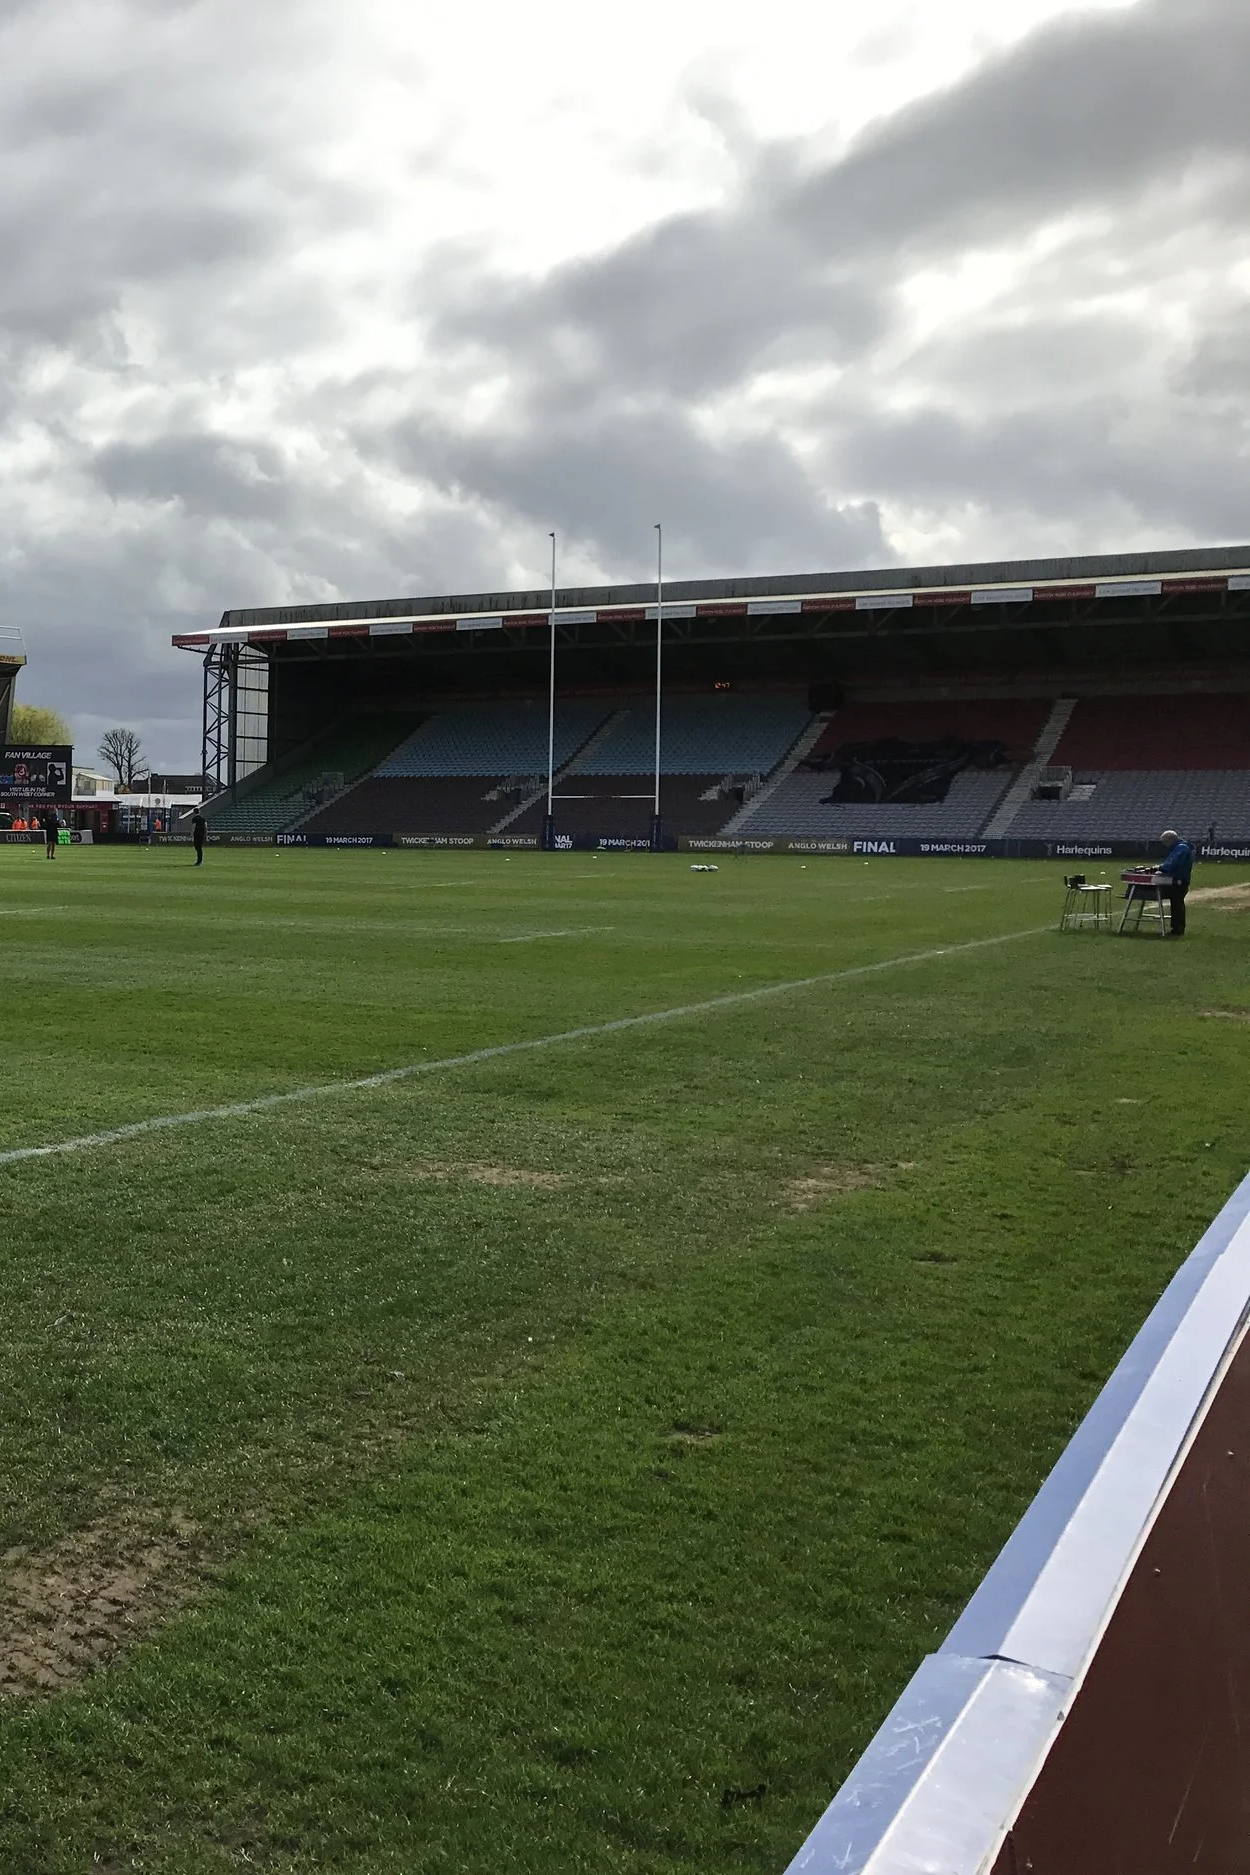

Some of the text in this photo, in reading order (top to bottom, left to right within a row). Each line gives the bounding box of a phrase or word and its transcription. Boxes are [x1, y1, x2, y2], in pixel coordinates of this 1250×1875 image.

[4, 751, 52, 760] FAN VILLAGE
[6, 833, 32, 842] CITIZEN
[277, 834, 307, 844] FINAL
[449, 837, 473, 845] STOOP
[599, 838, 650, 847] 19 MARCH 201
[688, 840, 743, 848] TWICKENHAM
[818, 842, 848, 850] WELSH
[853, 841, 896, 853] FINAL
[931, 844, 964, 852] MARCH
[965, 844, 986, 852] 2017
[1057, 844, 1112, 857] Harlequins
